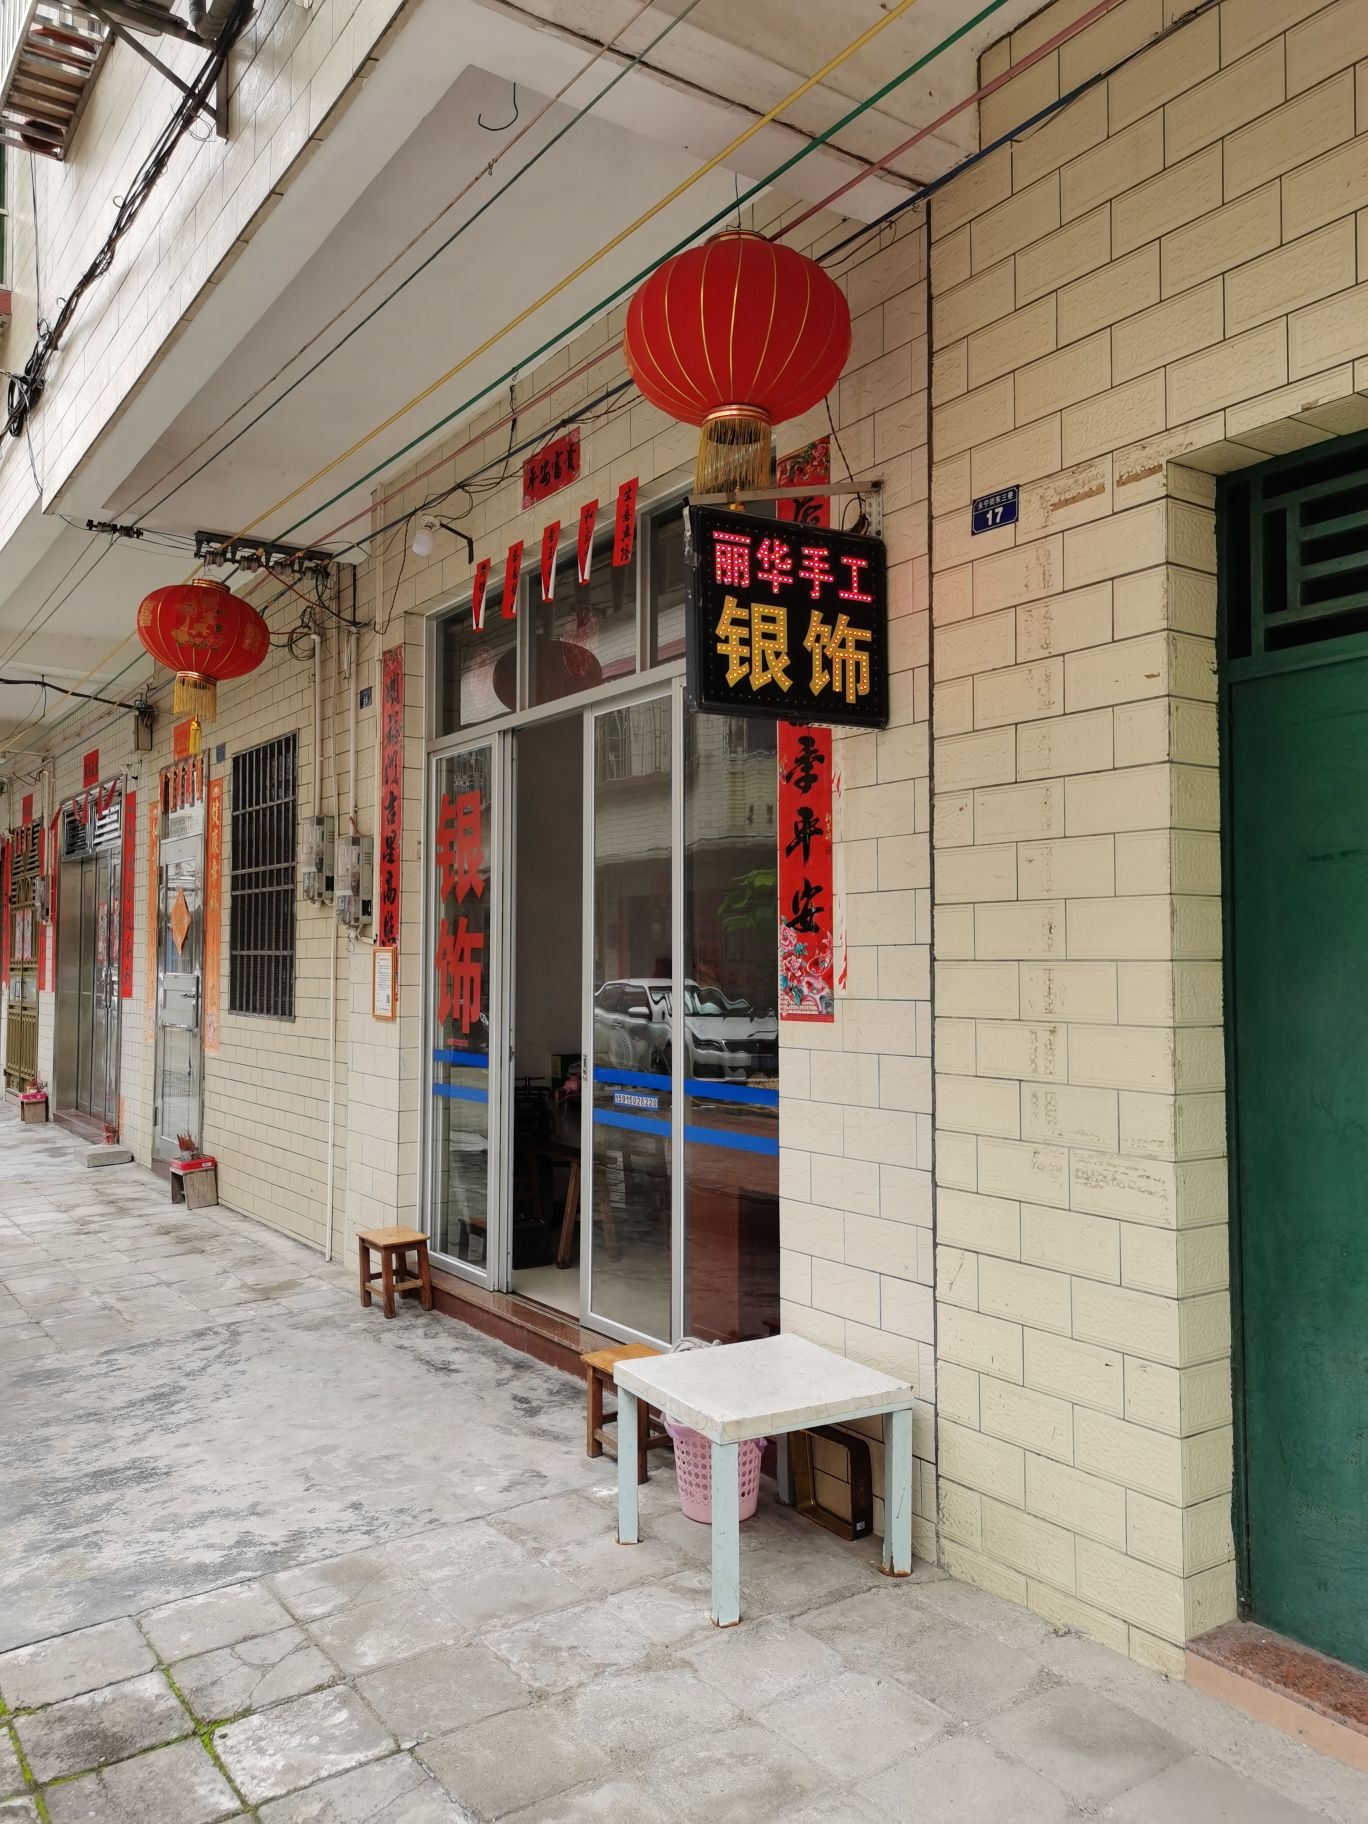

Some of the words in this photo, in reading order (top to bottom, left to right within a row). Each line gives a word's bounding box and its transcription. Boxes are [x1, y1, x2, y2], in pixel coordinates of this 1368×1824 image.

[712, 530, 873, 604] 丽华手工
[986, 506, 1004, 526] 17
[715, 595, 872, 704] 银饰
[785, 720, 826, 935] 季平安
[435, 790, 486, 1034] 银饰
